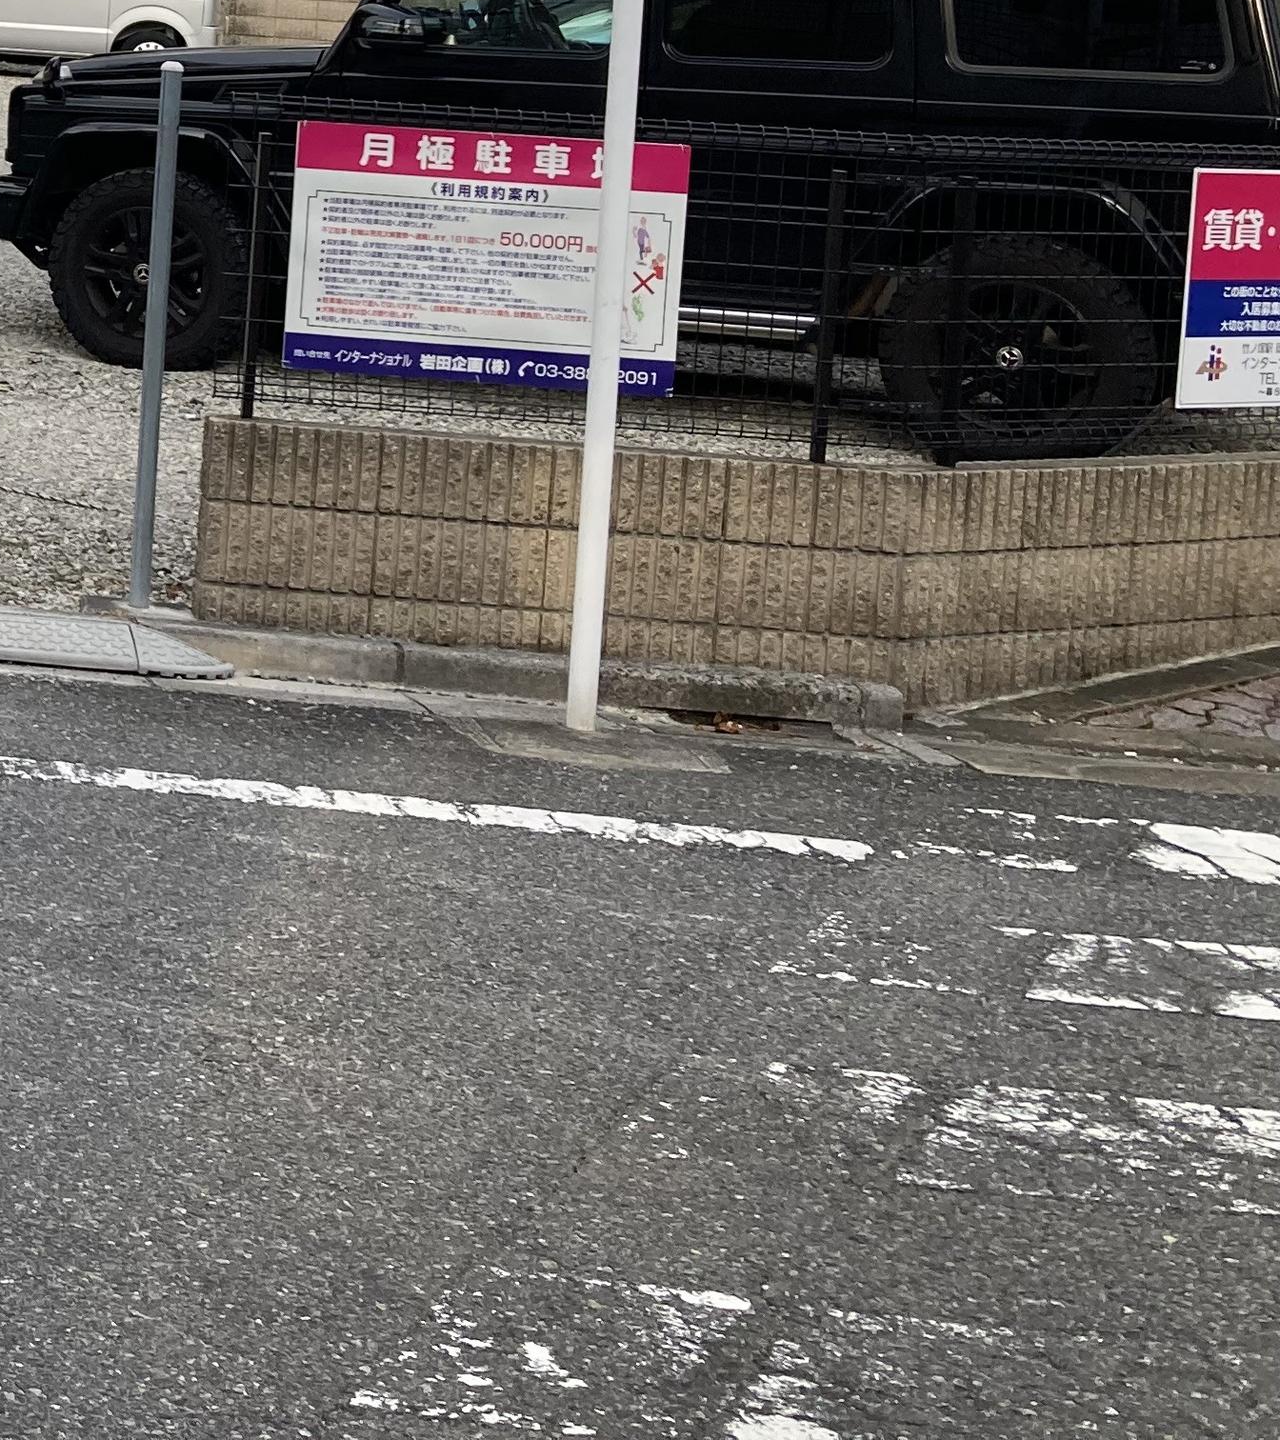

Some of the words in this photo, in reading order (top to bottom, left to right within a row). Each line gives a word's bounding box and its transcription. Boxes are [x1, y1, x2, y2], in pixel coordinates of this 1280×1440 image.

[499, 231, 584, 253] 50,000円
[334, 349, 414, 368] インターナショナル
[1259, 372, 1278, 385] TEL
